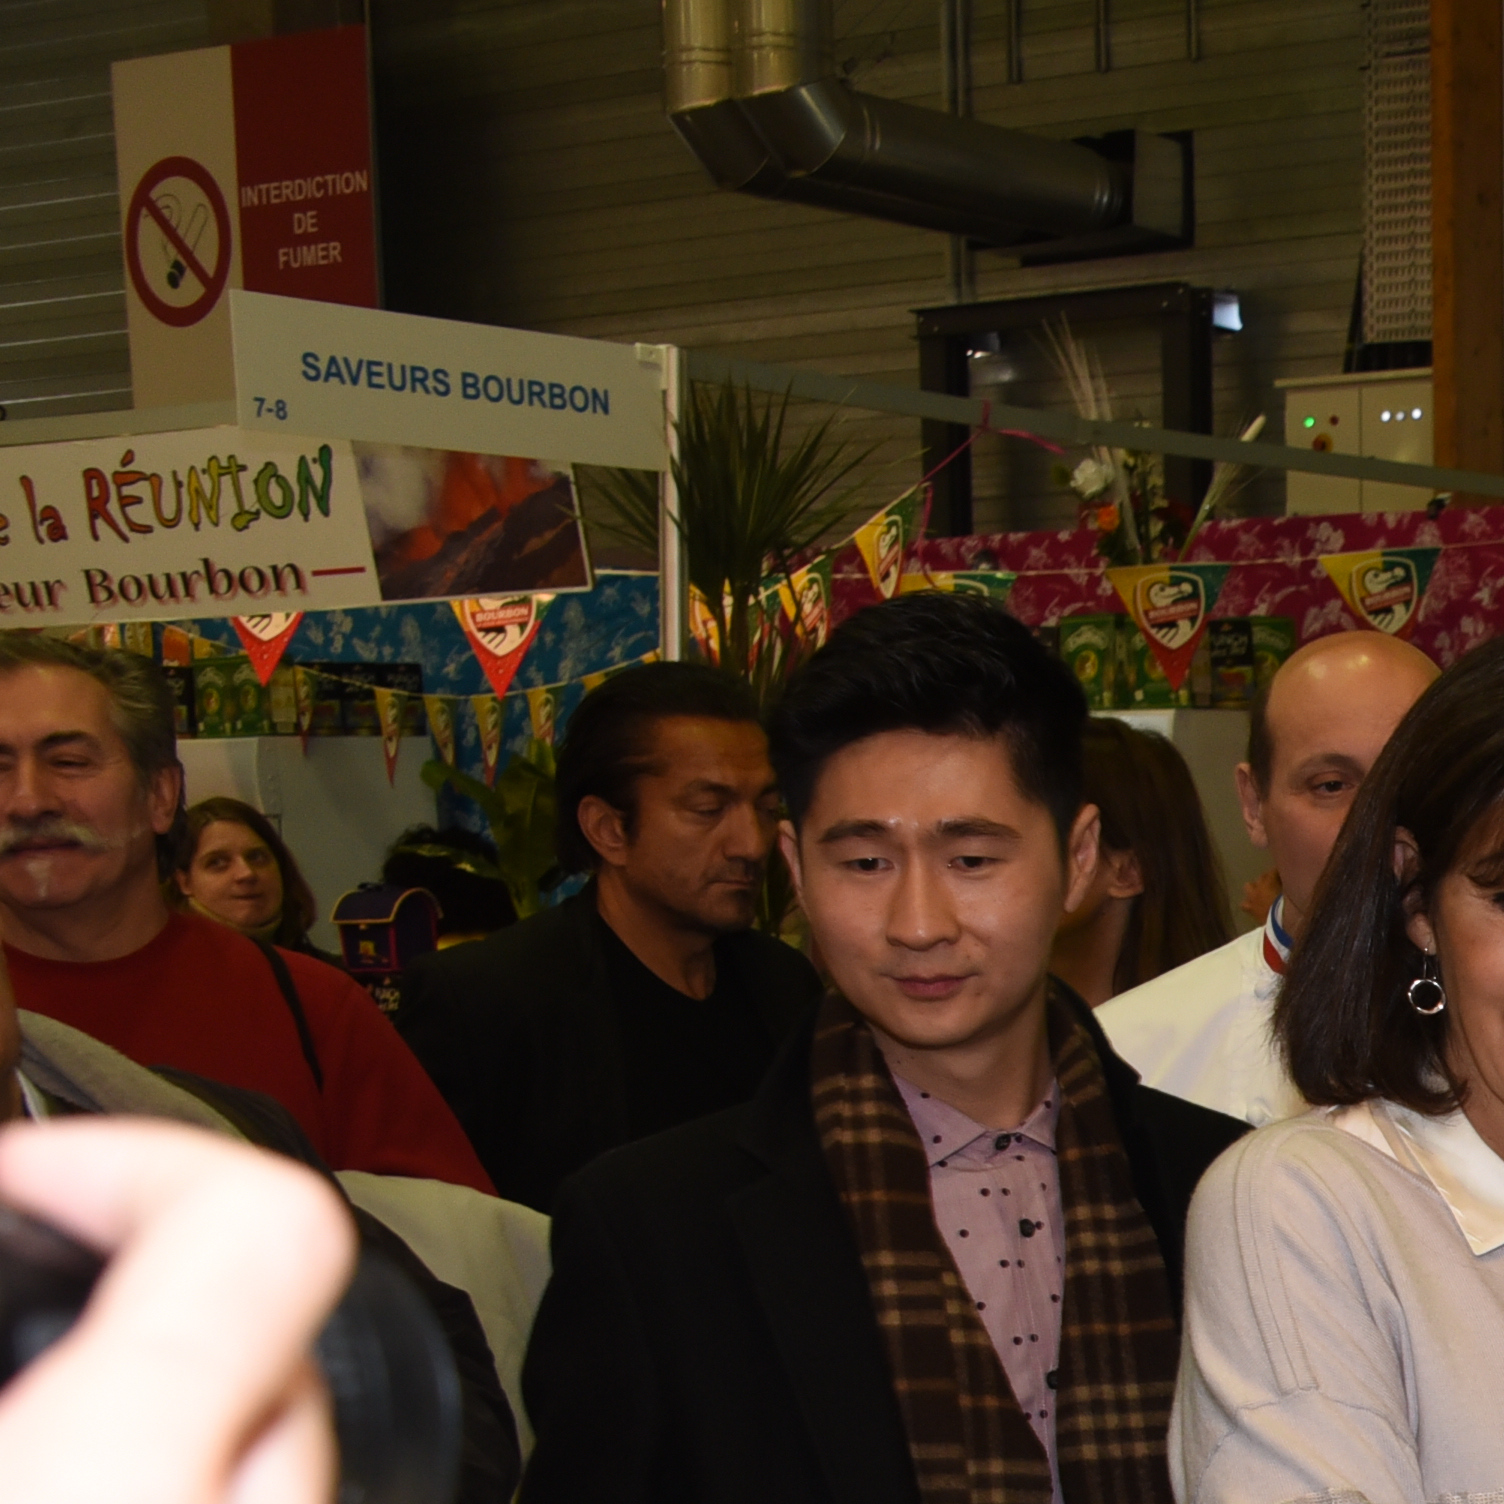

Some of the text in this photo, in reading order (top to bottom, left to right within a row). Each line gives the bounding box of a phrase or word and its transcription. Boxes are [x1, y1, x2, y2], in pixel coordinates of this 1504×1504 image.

[241, 170, 368, 208] INTERDICTION
[293, 211, 318, 234] DE
[278, 242, 342, 270] FUMER
[301, 352, 610, 415] SAVEURS BOURBON
[252, 397, 288, 420] 7-8
[20, 475, 68, 544] la
[83, 444, 332, 543] RÉUNION
[82, 558, 306, 605] Bourbon
[475, 606, 529, 622] BOURBON
